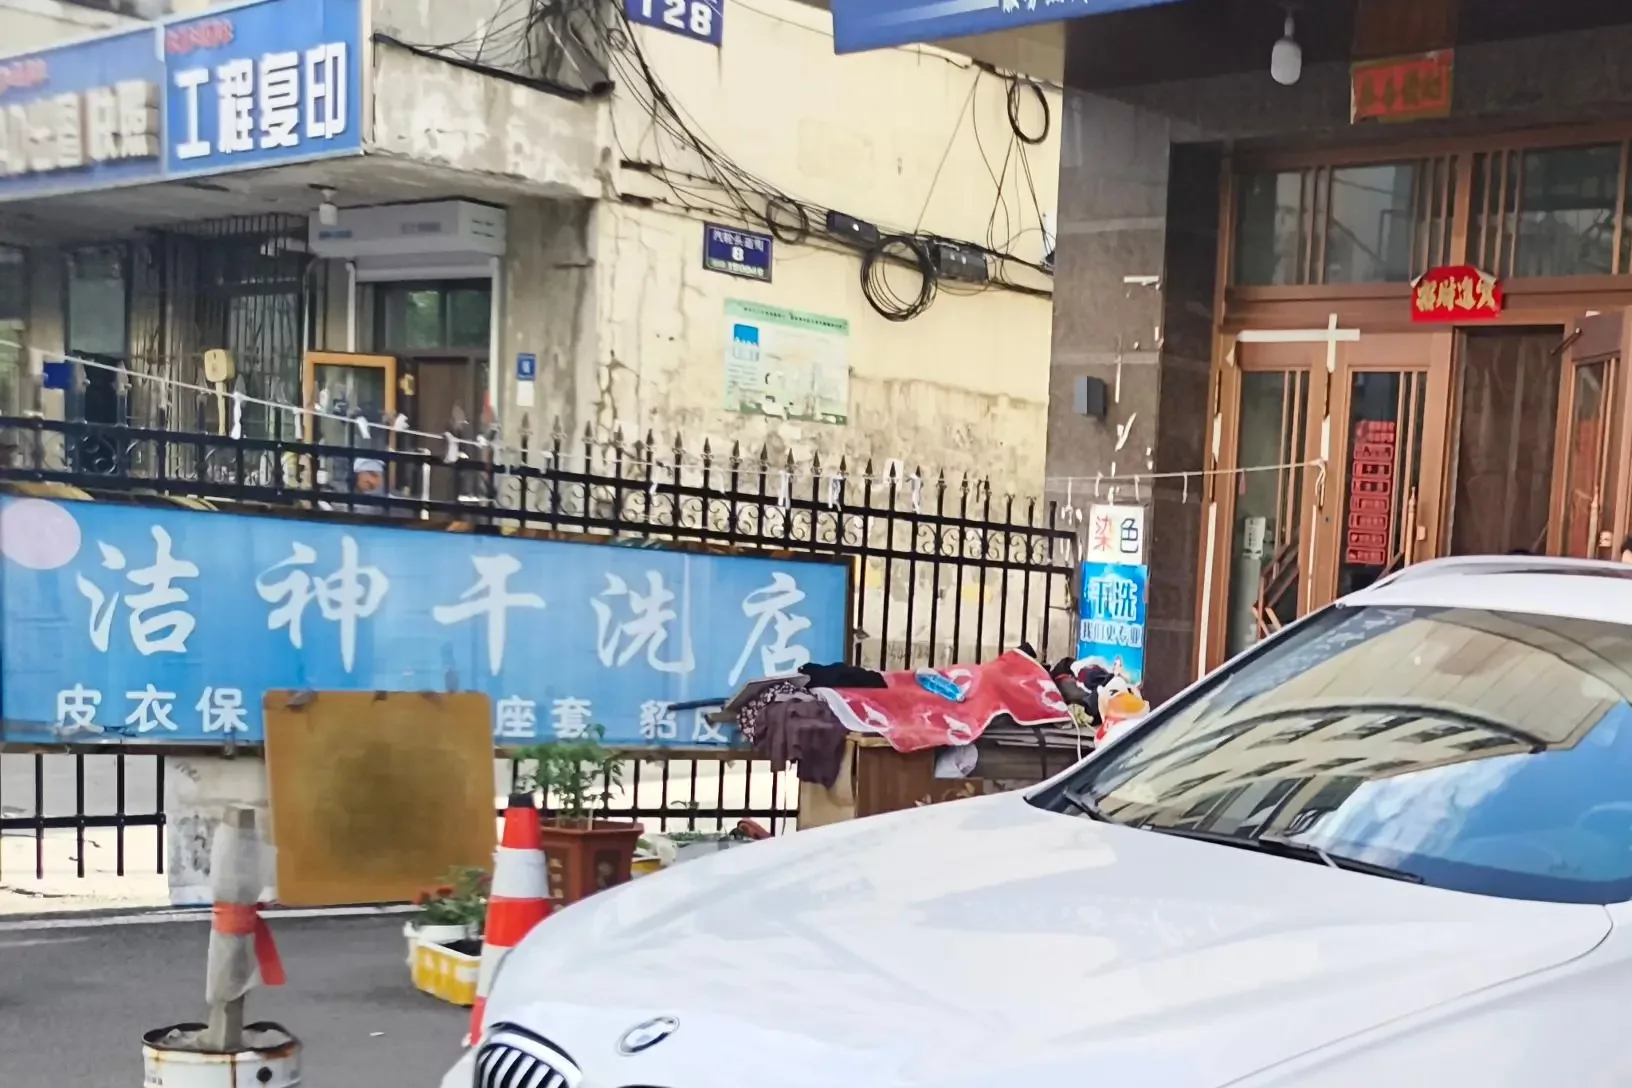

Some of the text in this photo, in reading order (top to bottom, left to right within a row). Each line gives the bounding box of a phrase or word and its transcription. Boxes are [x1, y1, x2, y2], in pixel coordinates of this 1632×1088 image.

[173, 41, 347, 159] 工程复印
[1094, 515, 1139, 554] 染色
[77, 525, 811, 686] 洁神干洗店
[1089, 576, 1138, 621] 干洗
[54, 683, 248, 734] 皮衣保
[495, 695, 592, 740] 座套
